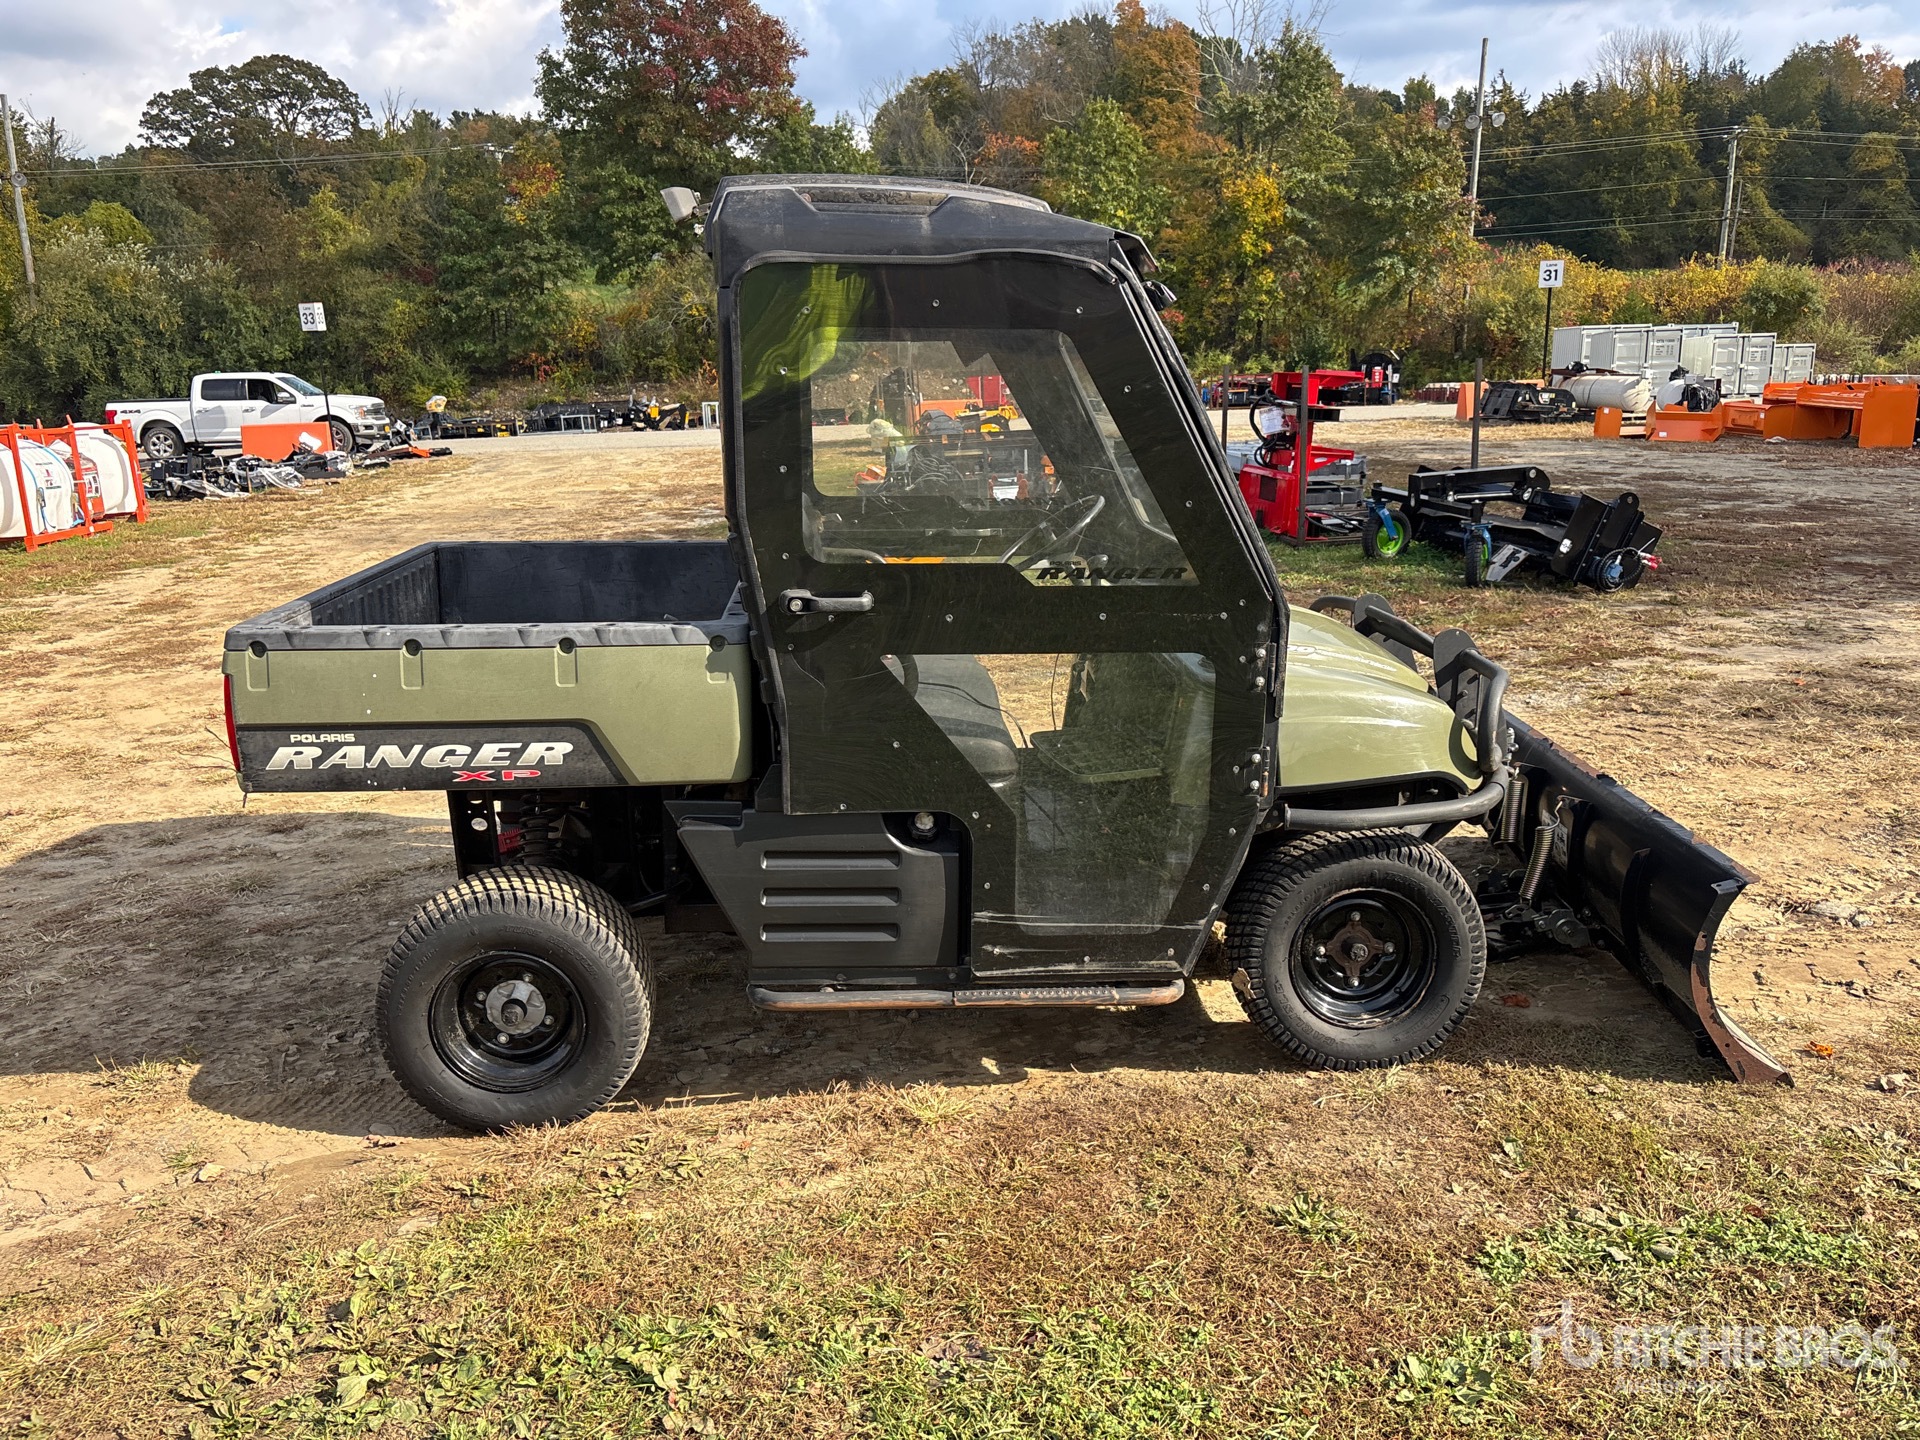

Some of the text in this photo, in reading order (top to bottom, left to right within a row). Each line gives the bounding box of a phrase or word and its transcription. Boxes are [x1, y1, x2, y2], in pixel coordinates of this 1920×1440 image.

[1543, 269, 1558, 281] 31
[302, 312, 315, 325] 33
[1036, 567, 1188, 580] RANGER
[290, 733, 355, 743] POLARIS
[265, 742, 574, 770] RANGER
[452, 769, 542, 782] XP
